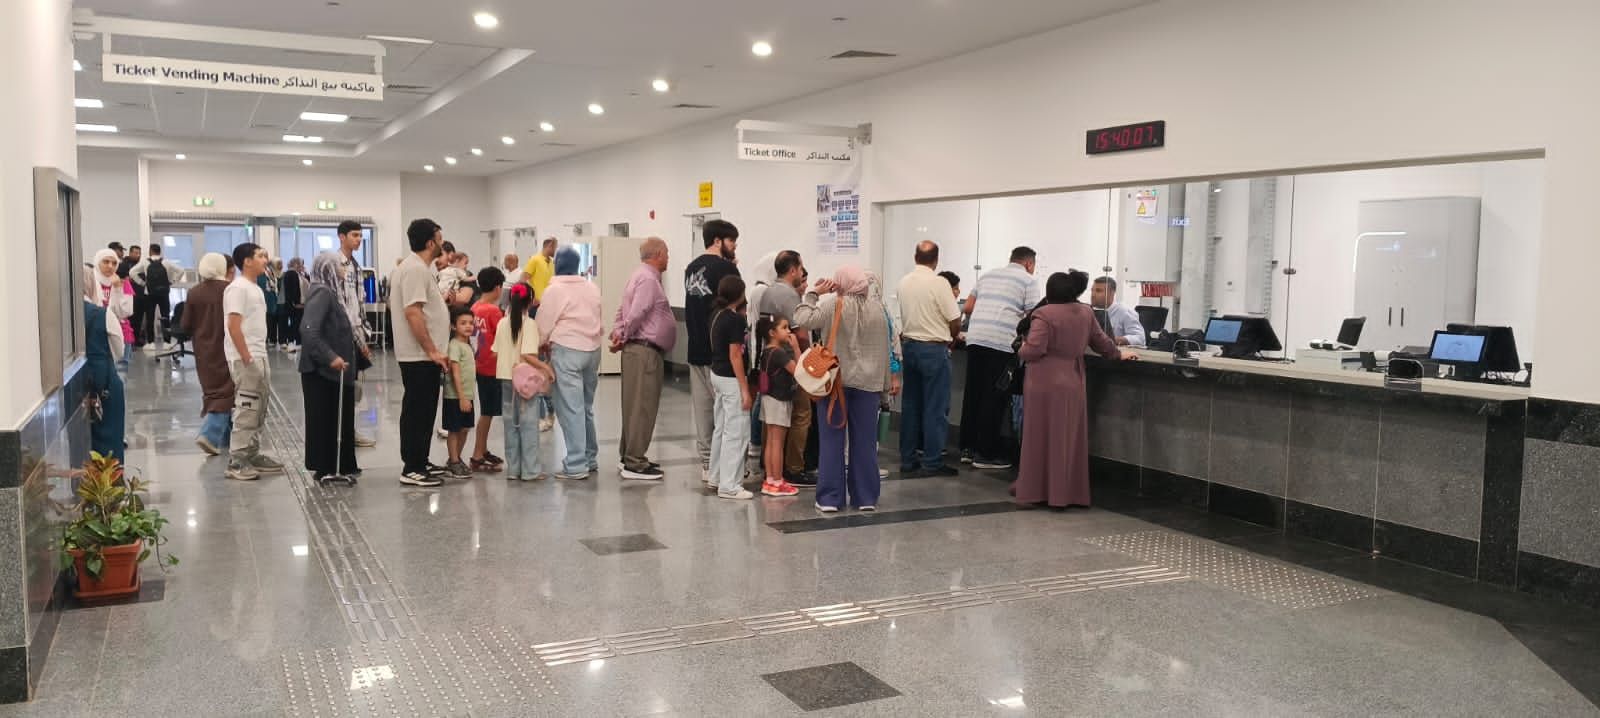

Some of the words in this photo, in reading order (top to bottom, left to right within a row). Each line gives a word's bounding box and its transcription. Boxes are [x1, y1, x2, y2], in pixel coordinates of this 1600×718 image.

[112, 63, 156, 77] Ticket
[161, 66, 219, 83] Vending
[223, 71, 280, 86] Machine
[282, 76, 318, 89] التذاكر
[1096, 126, 1153, 149] 15:40:07
[744, 147, 769, 157] Ticket
[771, 149, 797, 159] Office
